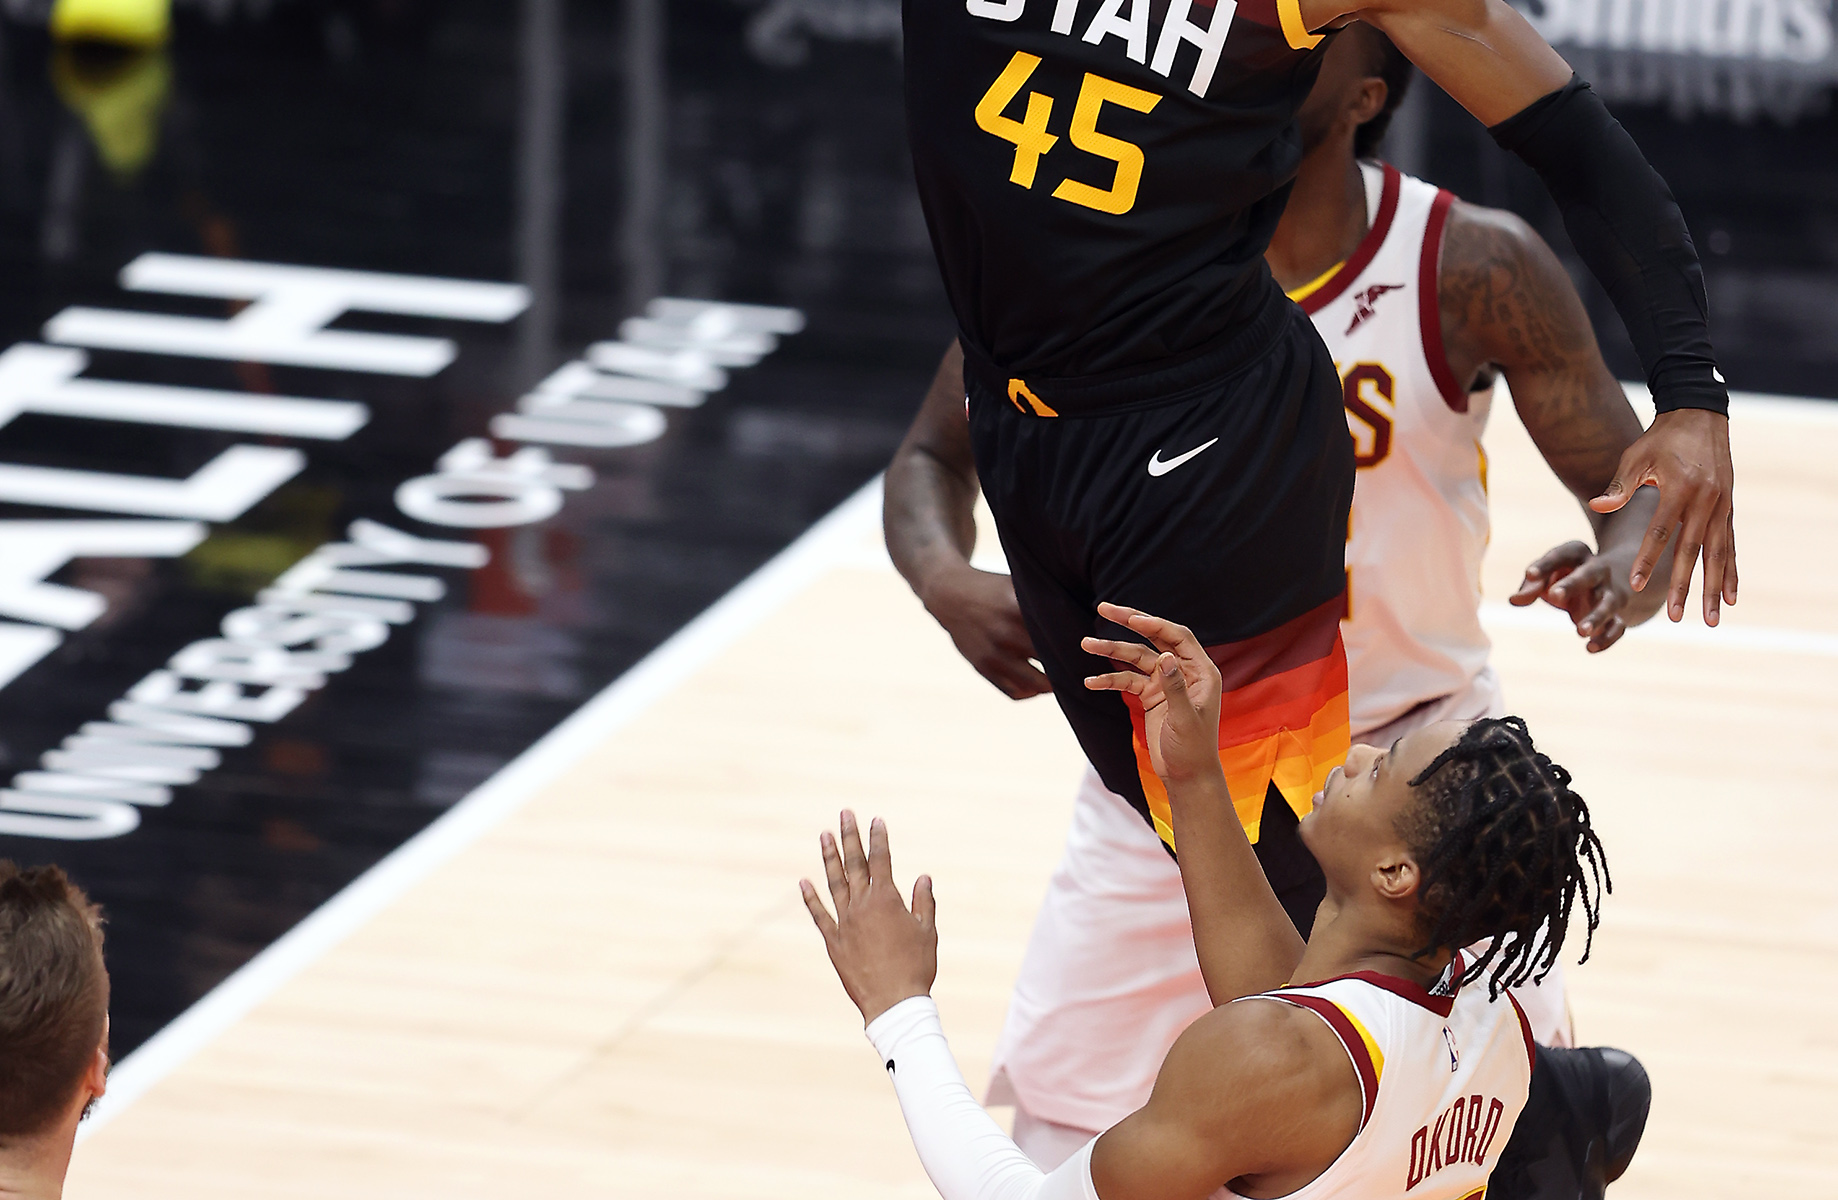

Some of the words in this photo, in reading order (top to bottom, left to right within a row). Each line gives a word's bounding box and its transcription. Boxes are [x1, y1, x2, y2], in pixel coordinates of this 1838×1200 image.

[974, 50, 1164, 216] 45
[490, 296, 805, 448] UTAH
[395, 436, 597, 529] OF
[0, 518, 492, 841] UNIVERSITY
[1405, 1094, 1505, 1192] OKORO
